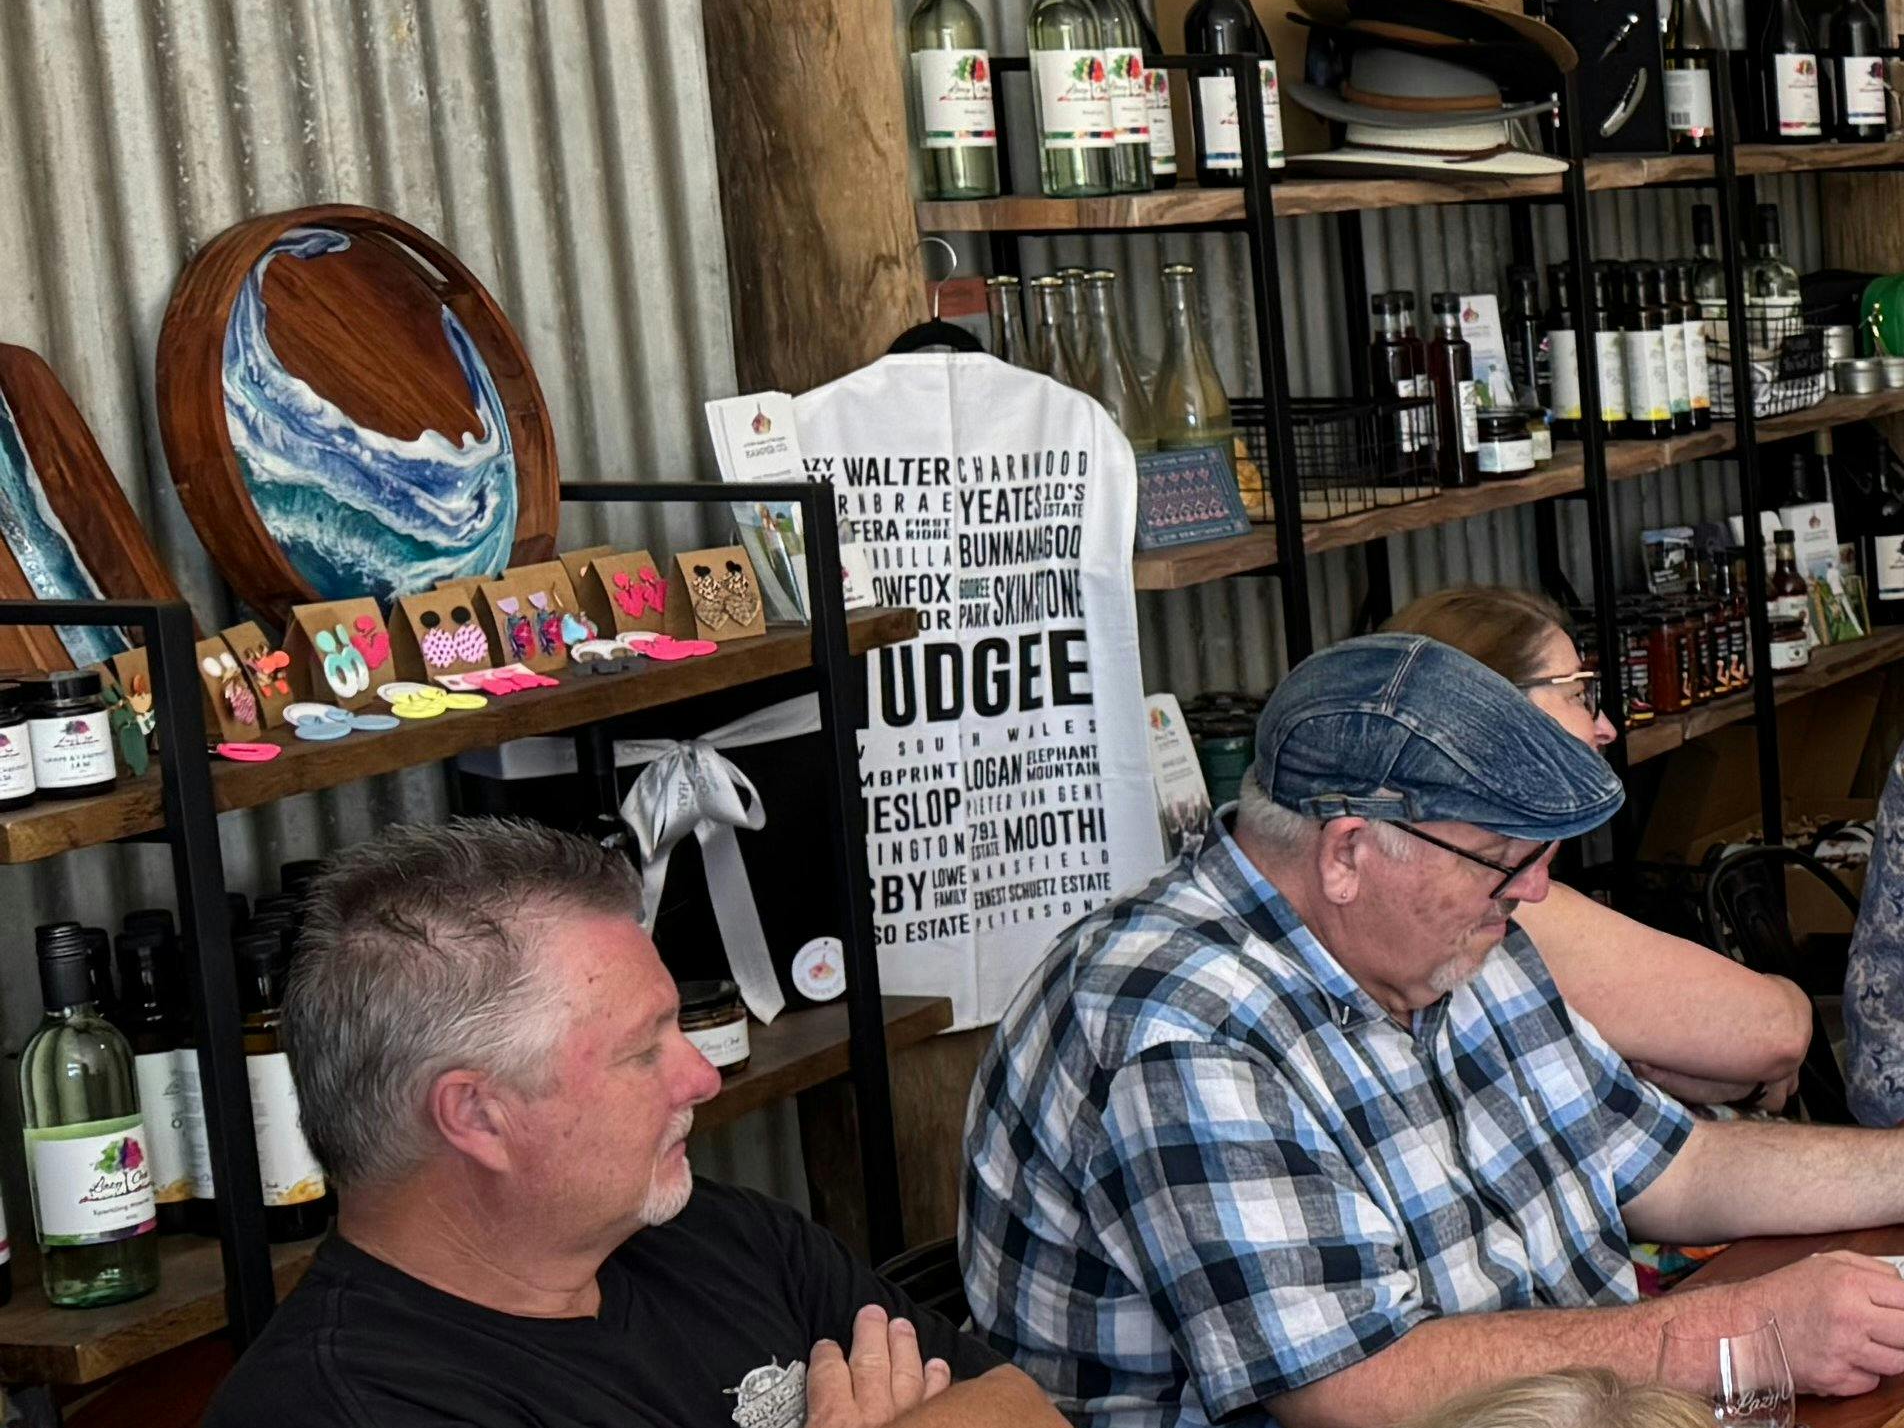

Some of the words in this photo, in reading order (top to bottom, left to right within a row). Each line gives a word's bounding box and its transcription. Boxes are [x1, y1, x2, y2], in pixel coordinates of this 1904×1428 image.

[803, 458, 834, 472] ZY
[843, 457, 951, 487] WALTER
[838, 492, 952, 515] RNBRAE
[959, 486, 1042, 526] YEATES
[1043, 503, 1083, 519] ESTATE
[850, 519, 900, 542] FERA
[959, 524, 1082, 568] BUNNAMGOO
[872, 573, 951, 608] OWFOX
[916, 608, 951, 631] OR
[959, 602, 990, 630] PARK
[899, 732, 980, 757] SOUH
[1007, 720, 1096, 744] WALES
[1027, 744, 1098, 766] ELEPHANT
[860, 762, 961, 789] MBPRINT
[964, 753, 1022, 793] LOGAN
[1027, 761, 1100, 783] MOUNTAIN
[1021, 788, 1045, 809] VAN
[1058, 783, 1103, 804] GENT
[969, 819, 998, 843] 791
[1004, 807, 1107, 854] MOOTHI
[878, 832, 965, 866] INGTON
[971, 841, 1000, 862] ESTATE
[932, 865, 967, 889] LOWE
[972, 849, 1110, 883] MANSFIELD
[868, 870, 927, 915] BY
[934, 888, 967, 909] FAMILY
[974, 884, 1007, 911] ERNEST
[1008, 878, 1057, 903] SCHUETZ
[1061, 872, 1112, 895] ESTATE
[874, 924, 897, 946] SO
[905, 913, 971, 944] ESTATE
[976, 897, 1113, 932] PETERSON
